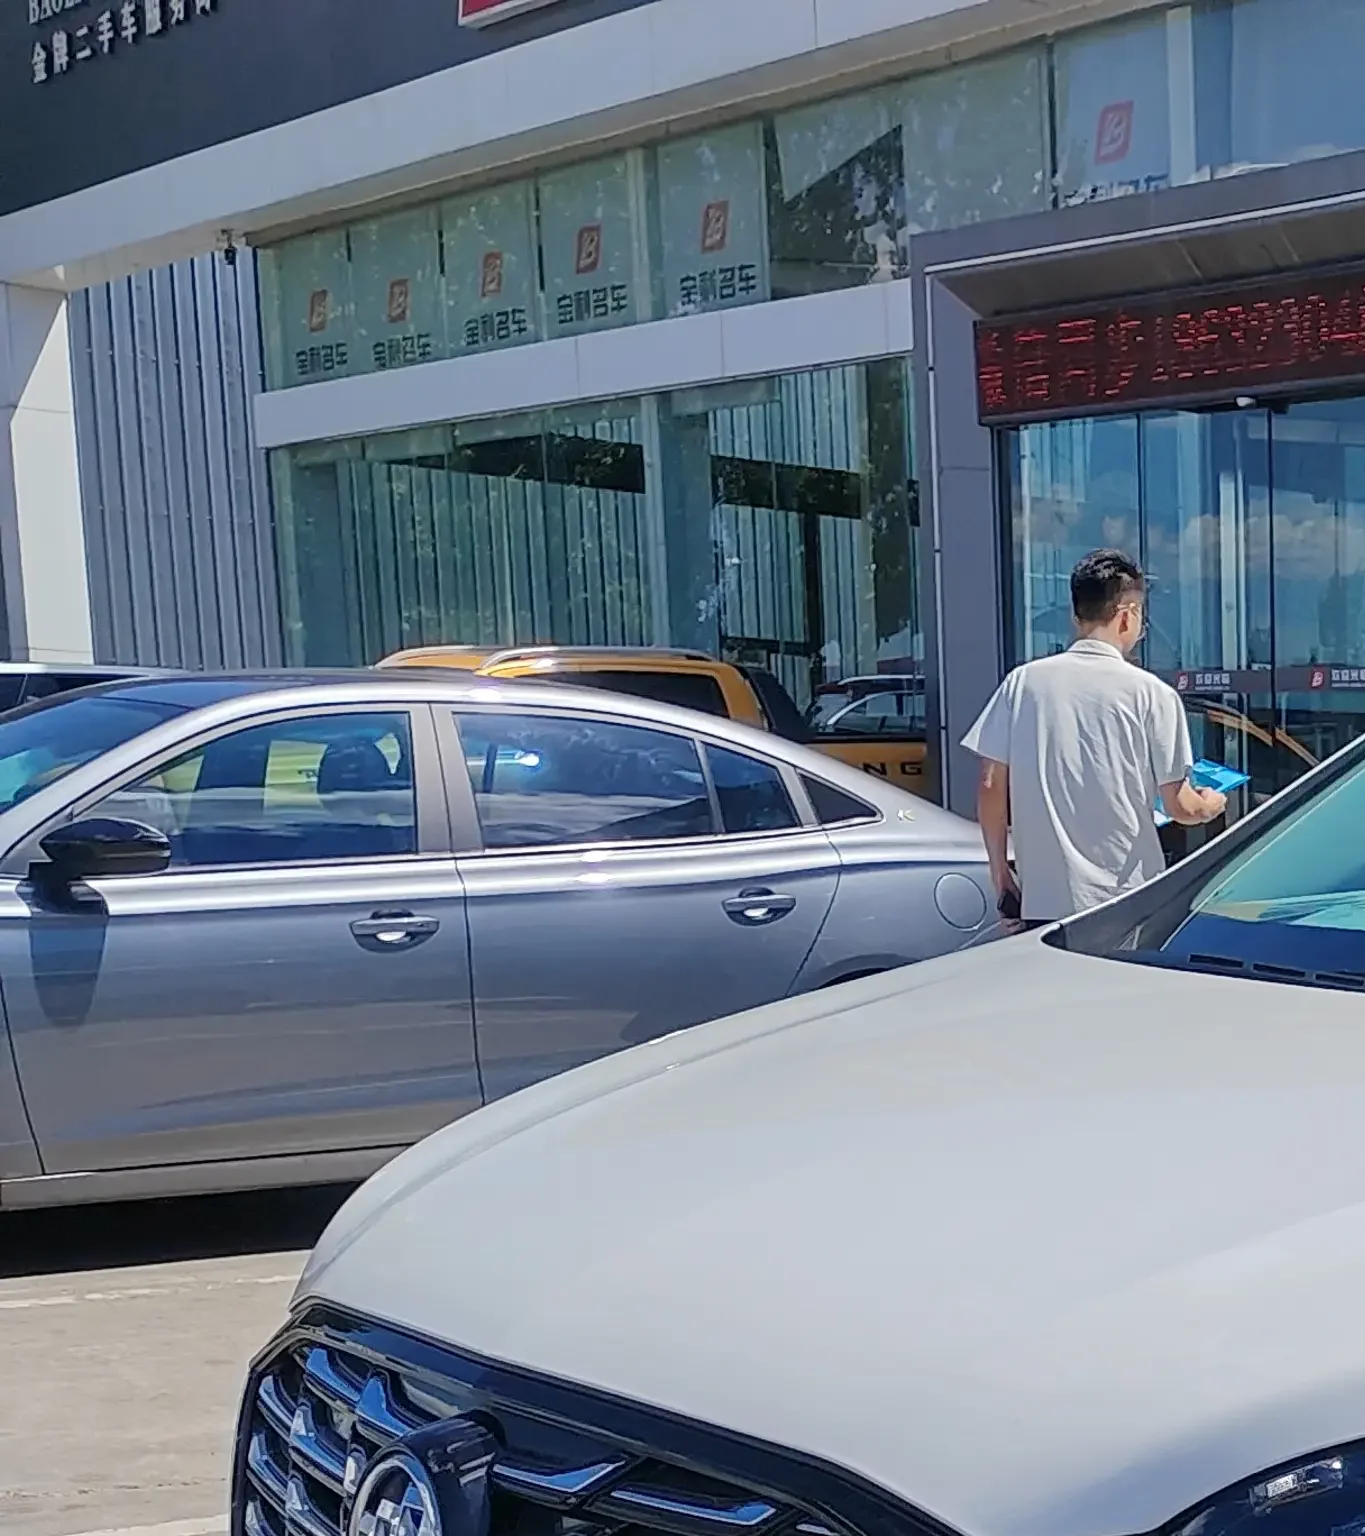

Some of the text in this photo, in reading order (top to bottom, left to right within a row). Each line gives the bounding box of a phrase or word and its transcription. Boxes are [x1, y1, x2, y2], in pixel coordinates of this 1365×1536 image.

[557, 284, 627, 325] 宝利名车
[680, 264, 757, 306] 宝利名车
[464, 308, 528, 347] 宝利名车
[296, 342, 348, 376] 宝利名车
